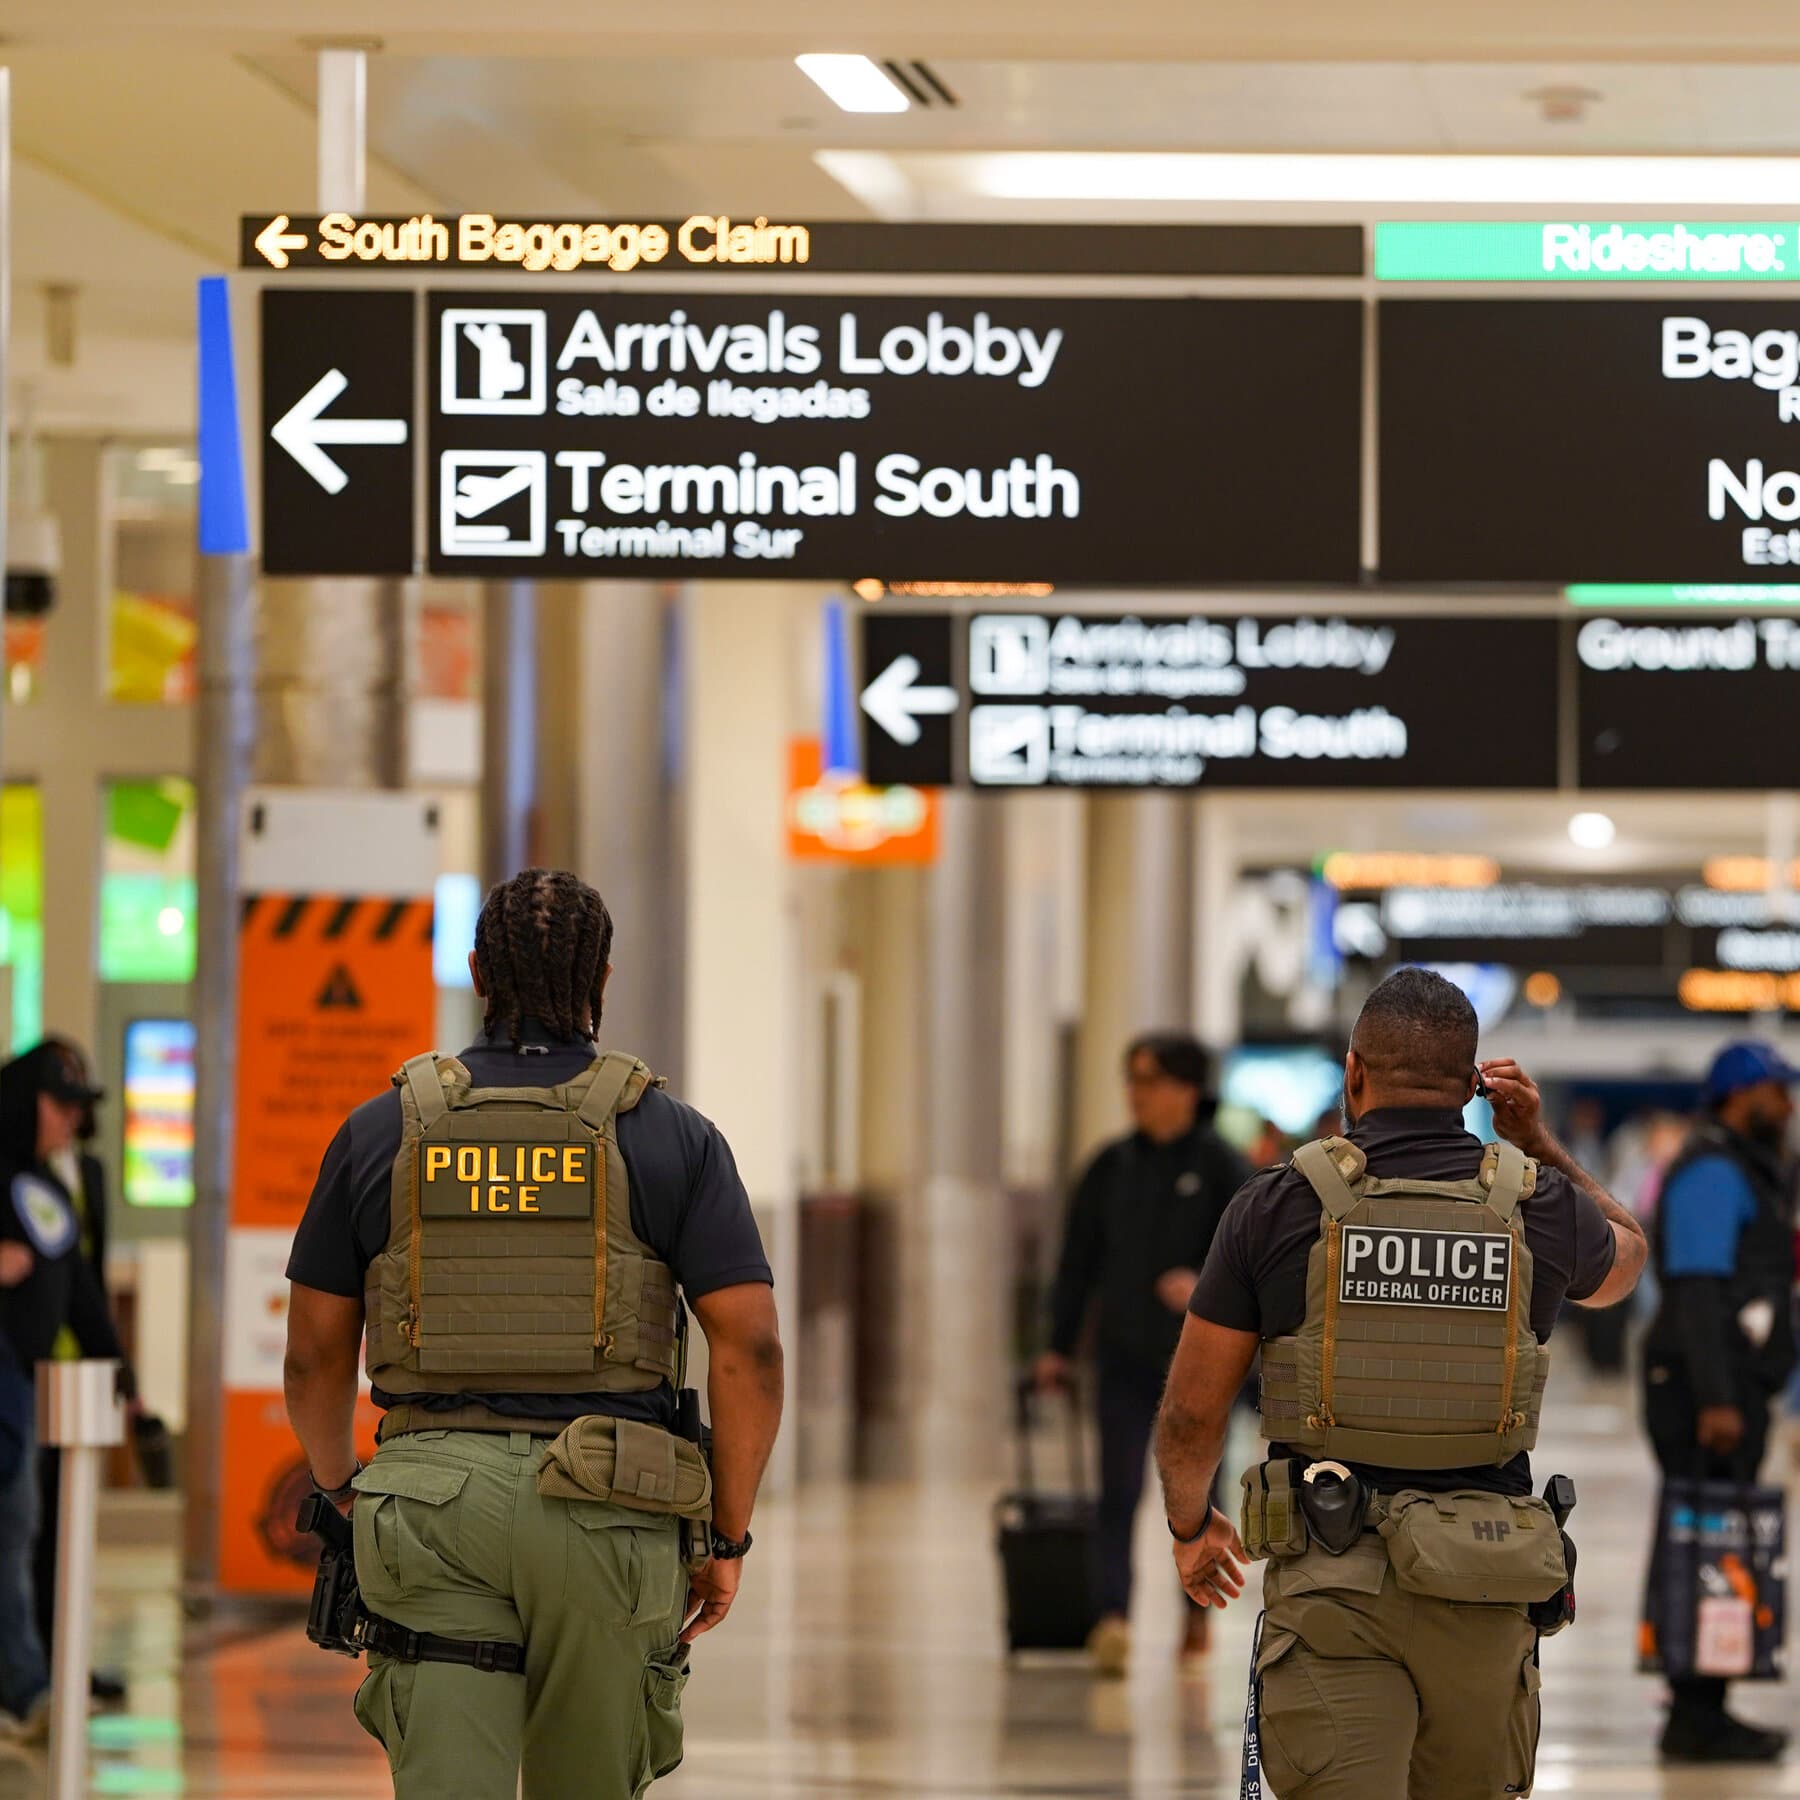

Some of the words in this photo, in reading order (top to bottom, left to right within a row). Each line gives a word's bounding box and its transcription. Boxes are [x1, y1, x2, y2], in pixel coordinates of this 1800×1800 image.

[318, 213, 449, 262] South
[458, 213, 669, 271] Baggage
[677, 215, 811, 263] Claim
[1542, 223, 1785, 272] Rideshare:
[557, 310, 821, 373] Arrivals
[836, 312, 1063, 387] Lobby
[1662, 317, 1800, 390] Bag
[556, 378, 640, 416] Sala
[646, 378, 700, 416] de
[708, 379, 870, 423] llegadas
[555, 451, 857, 516] Terminal
[874, 454, 1080, 519] South
[1709, 459, 1800, 521] No
[556, 520, 726, 558] Terminal
[733, 521, 803, 558] Sur
[1259, 705, 1407, 759] South
[426, 1146, 587, 1184] POLICE
[470, 1185, 541, 1213] ICE
[1346, 1233, 1506, 1281] POLICE
[1344, 1279, 1422, 1300] FEDERAL
[1427, 1283, 1503, 1305] OFFICER
[1471, 1520, 1511, 1542] HP
[1247, 1732, 1259, 1767] DHS
